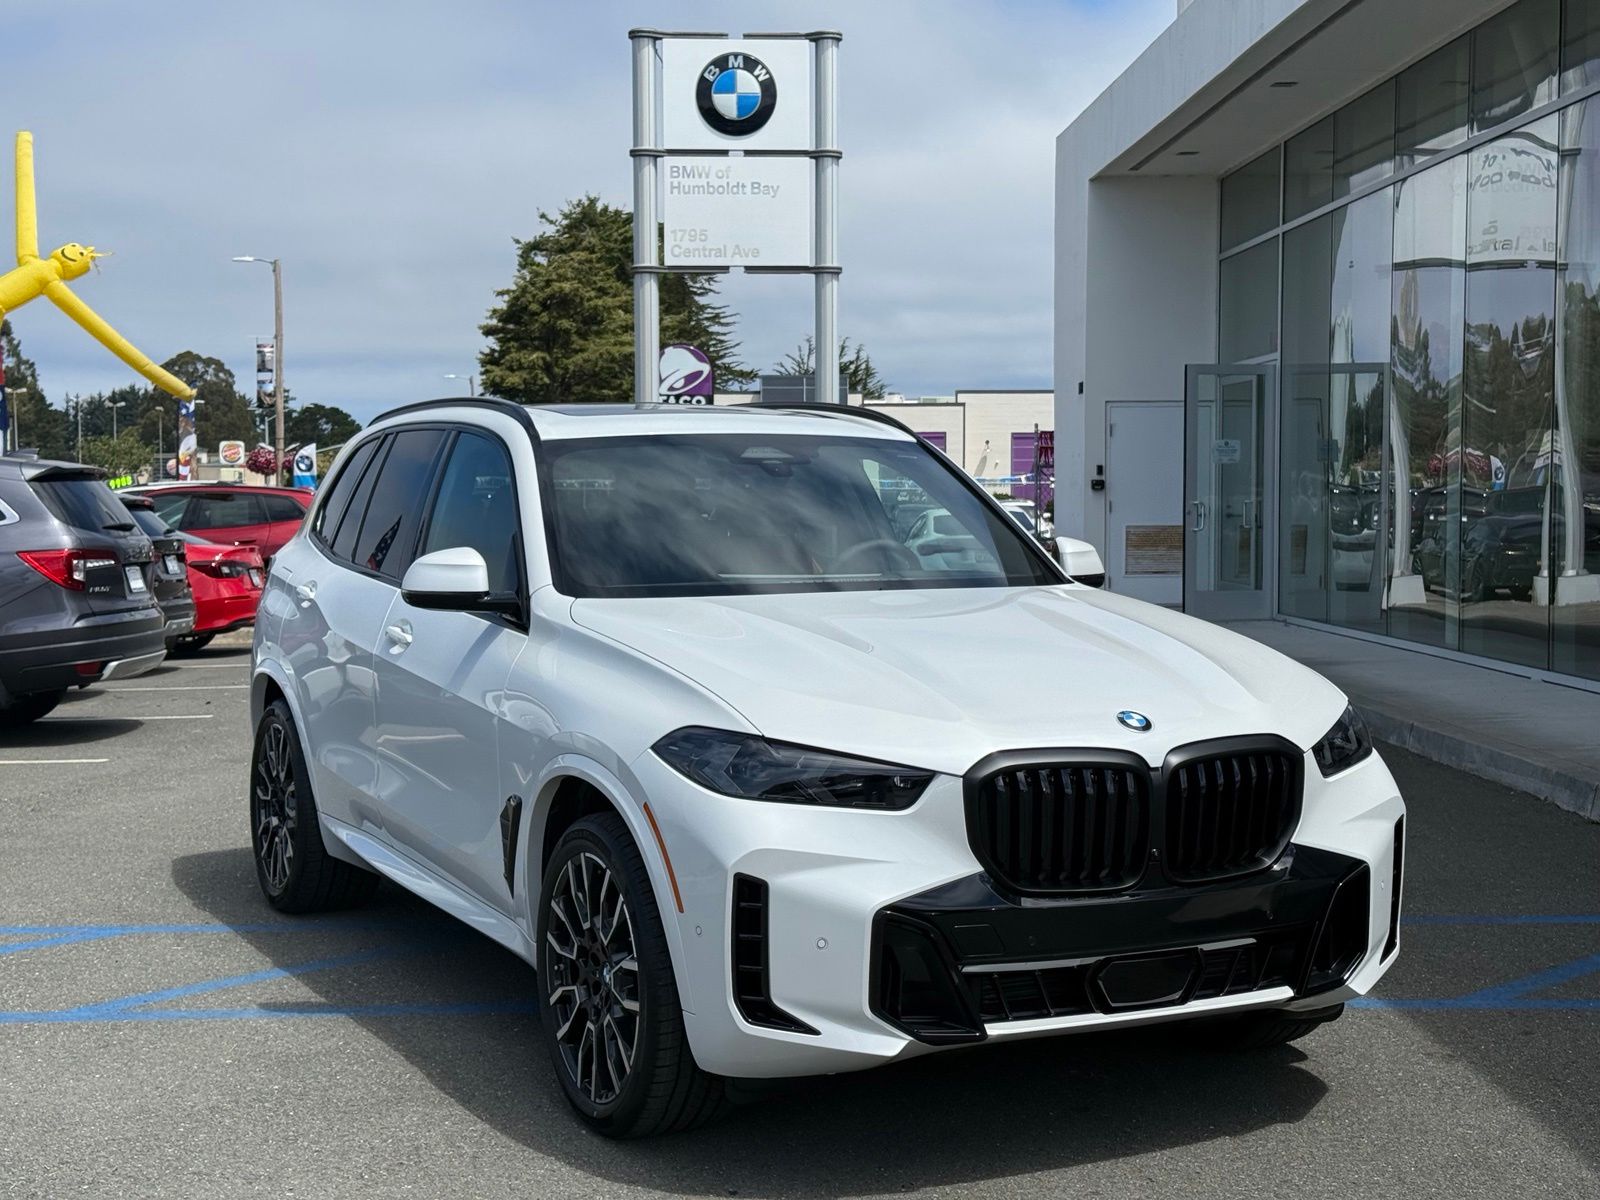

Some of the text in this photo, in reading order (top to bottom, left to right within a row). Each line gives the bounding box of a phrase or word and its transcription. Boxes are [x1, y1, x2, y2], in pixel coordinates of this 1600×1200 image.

[703, 55, 770, 82] BMW
[669, 165, 731, 180] BMW of
[669, 181, 780, 199] Humboldt Bay
[670, 228, 709, 243] 1795
[670, 243, 761, 259] Central Ave
